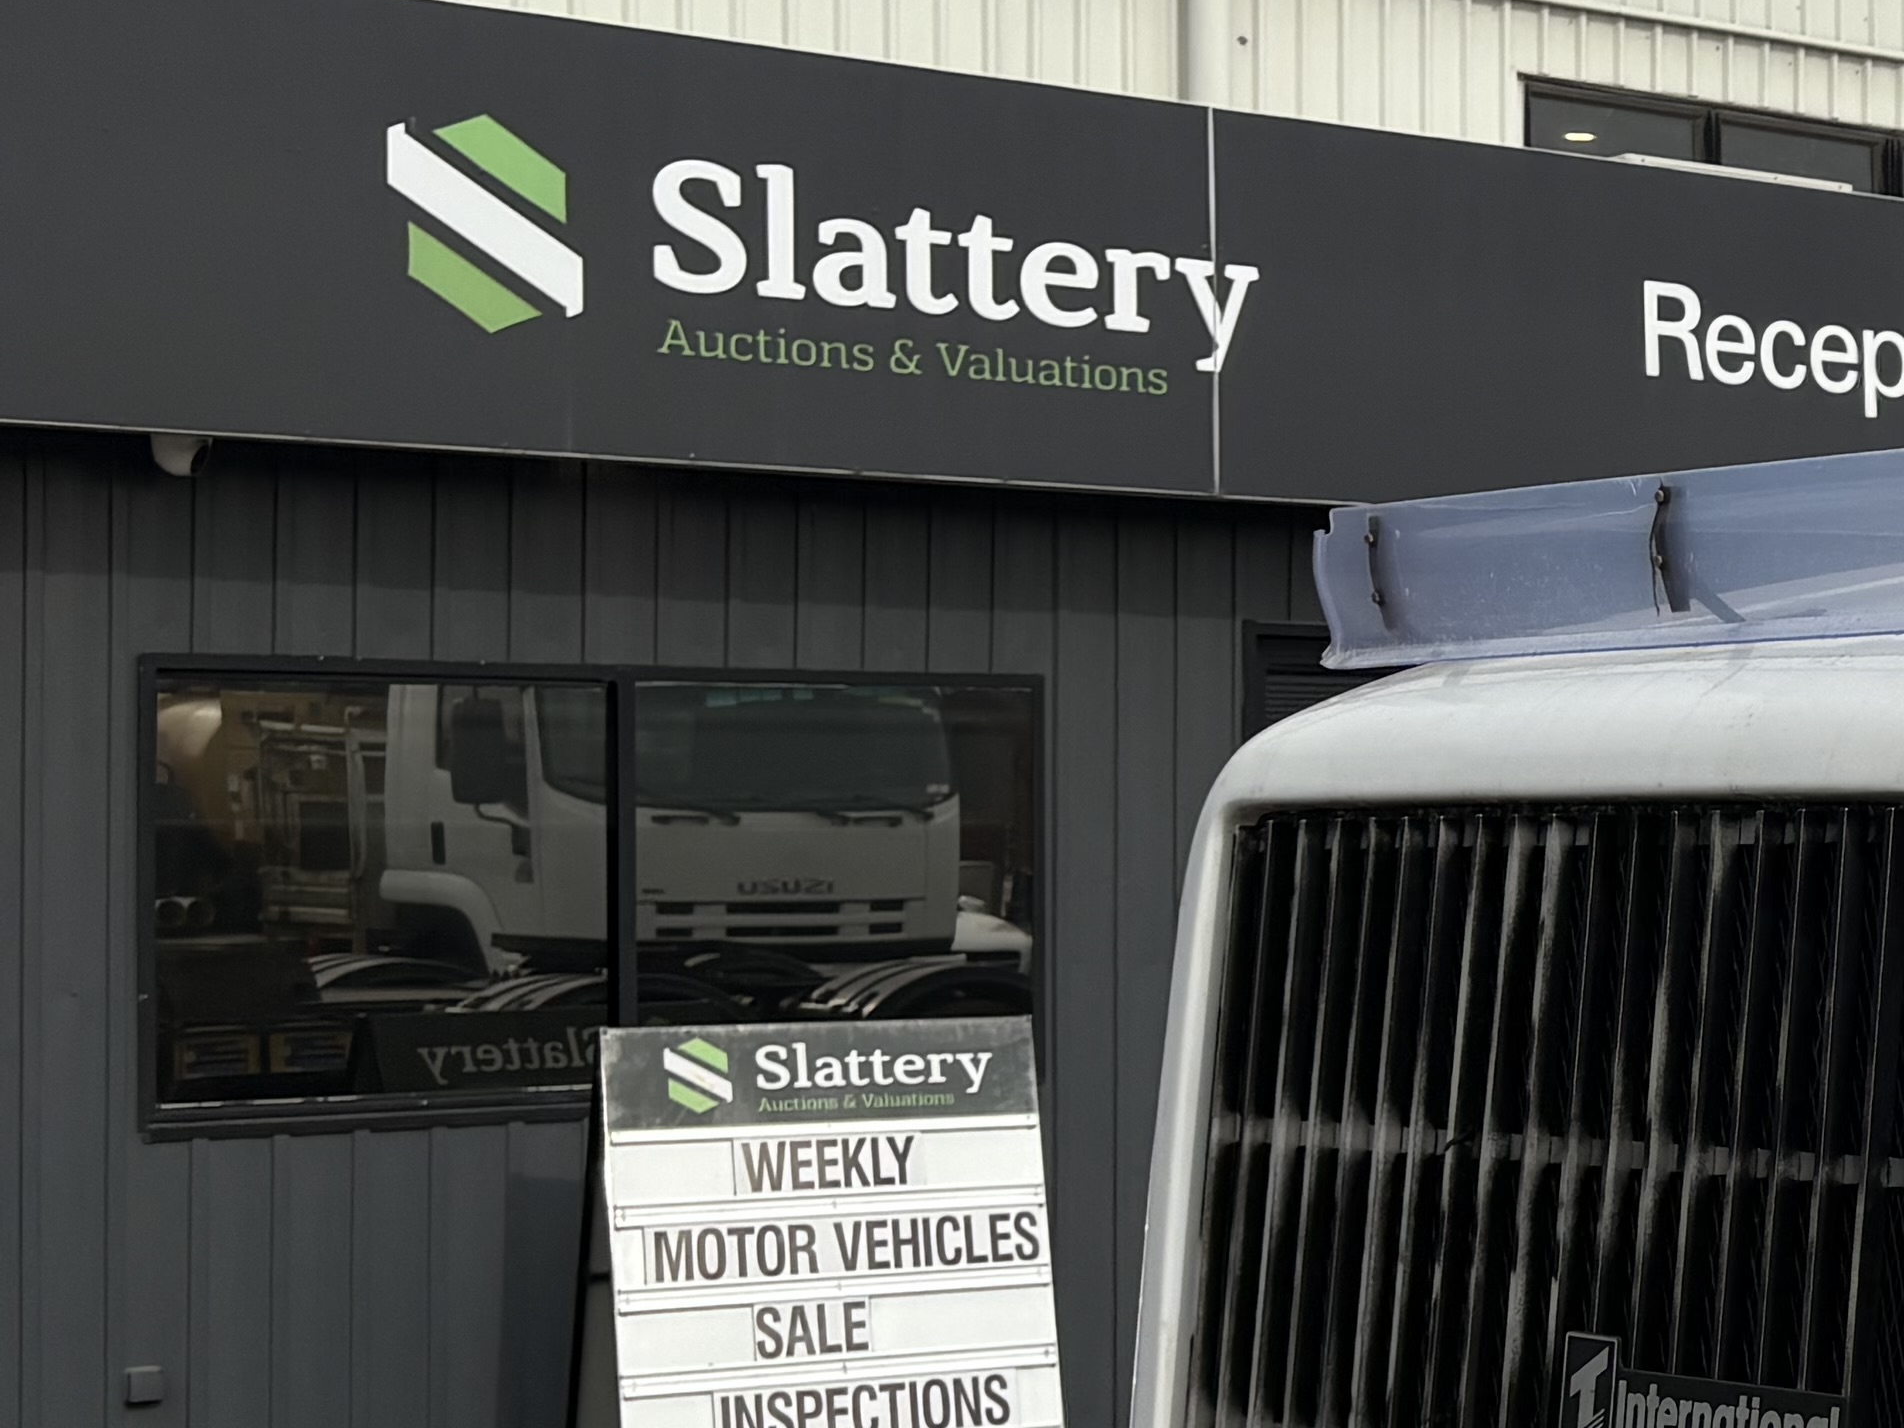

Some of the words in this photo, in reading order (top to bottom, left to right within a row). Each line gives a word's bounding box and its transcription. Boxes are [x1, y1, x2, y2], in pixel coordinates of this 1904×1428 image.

[652, 159, 1260, 372] Slattery
[656, 319, 875, 372] Auctions
[889, 338, 923, 375] &
[936, 341, 1169, 396] Valuations
[754, 1042, 993, 1094] Slattery
[758, 1096, 839, 1113] Auctions
[861, 1093, 955, 1110] Valuations
[741, 1135, 916, 1193] WEEKLY
[652, 1223, 819, 1283] MOTOR
[833, 1211, 1040, 1272] VEHICLES
[756, 1300, 870, 1359] SALE
